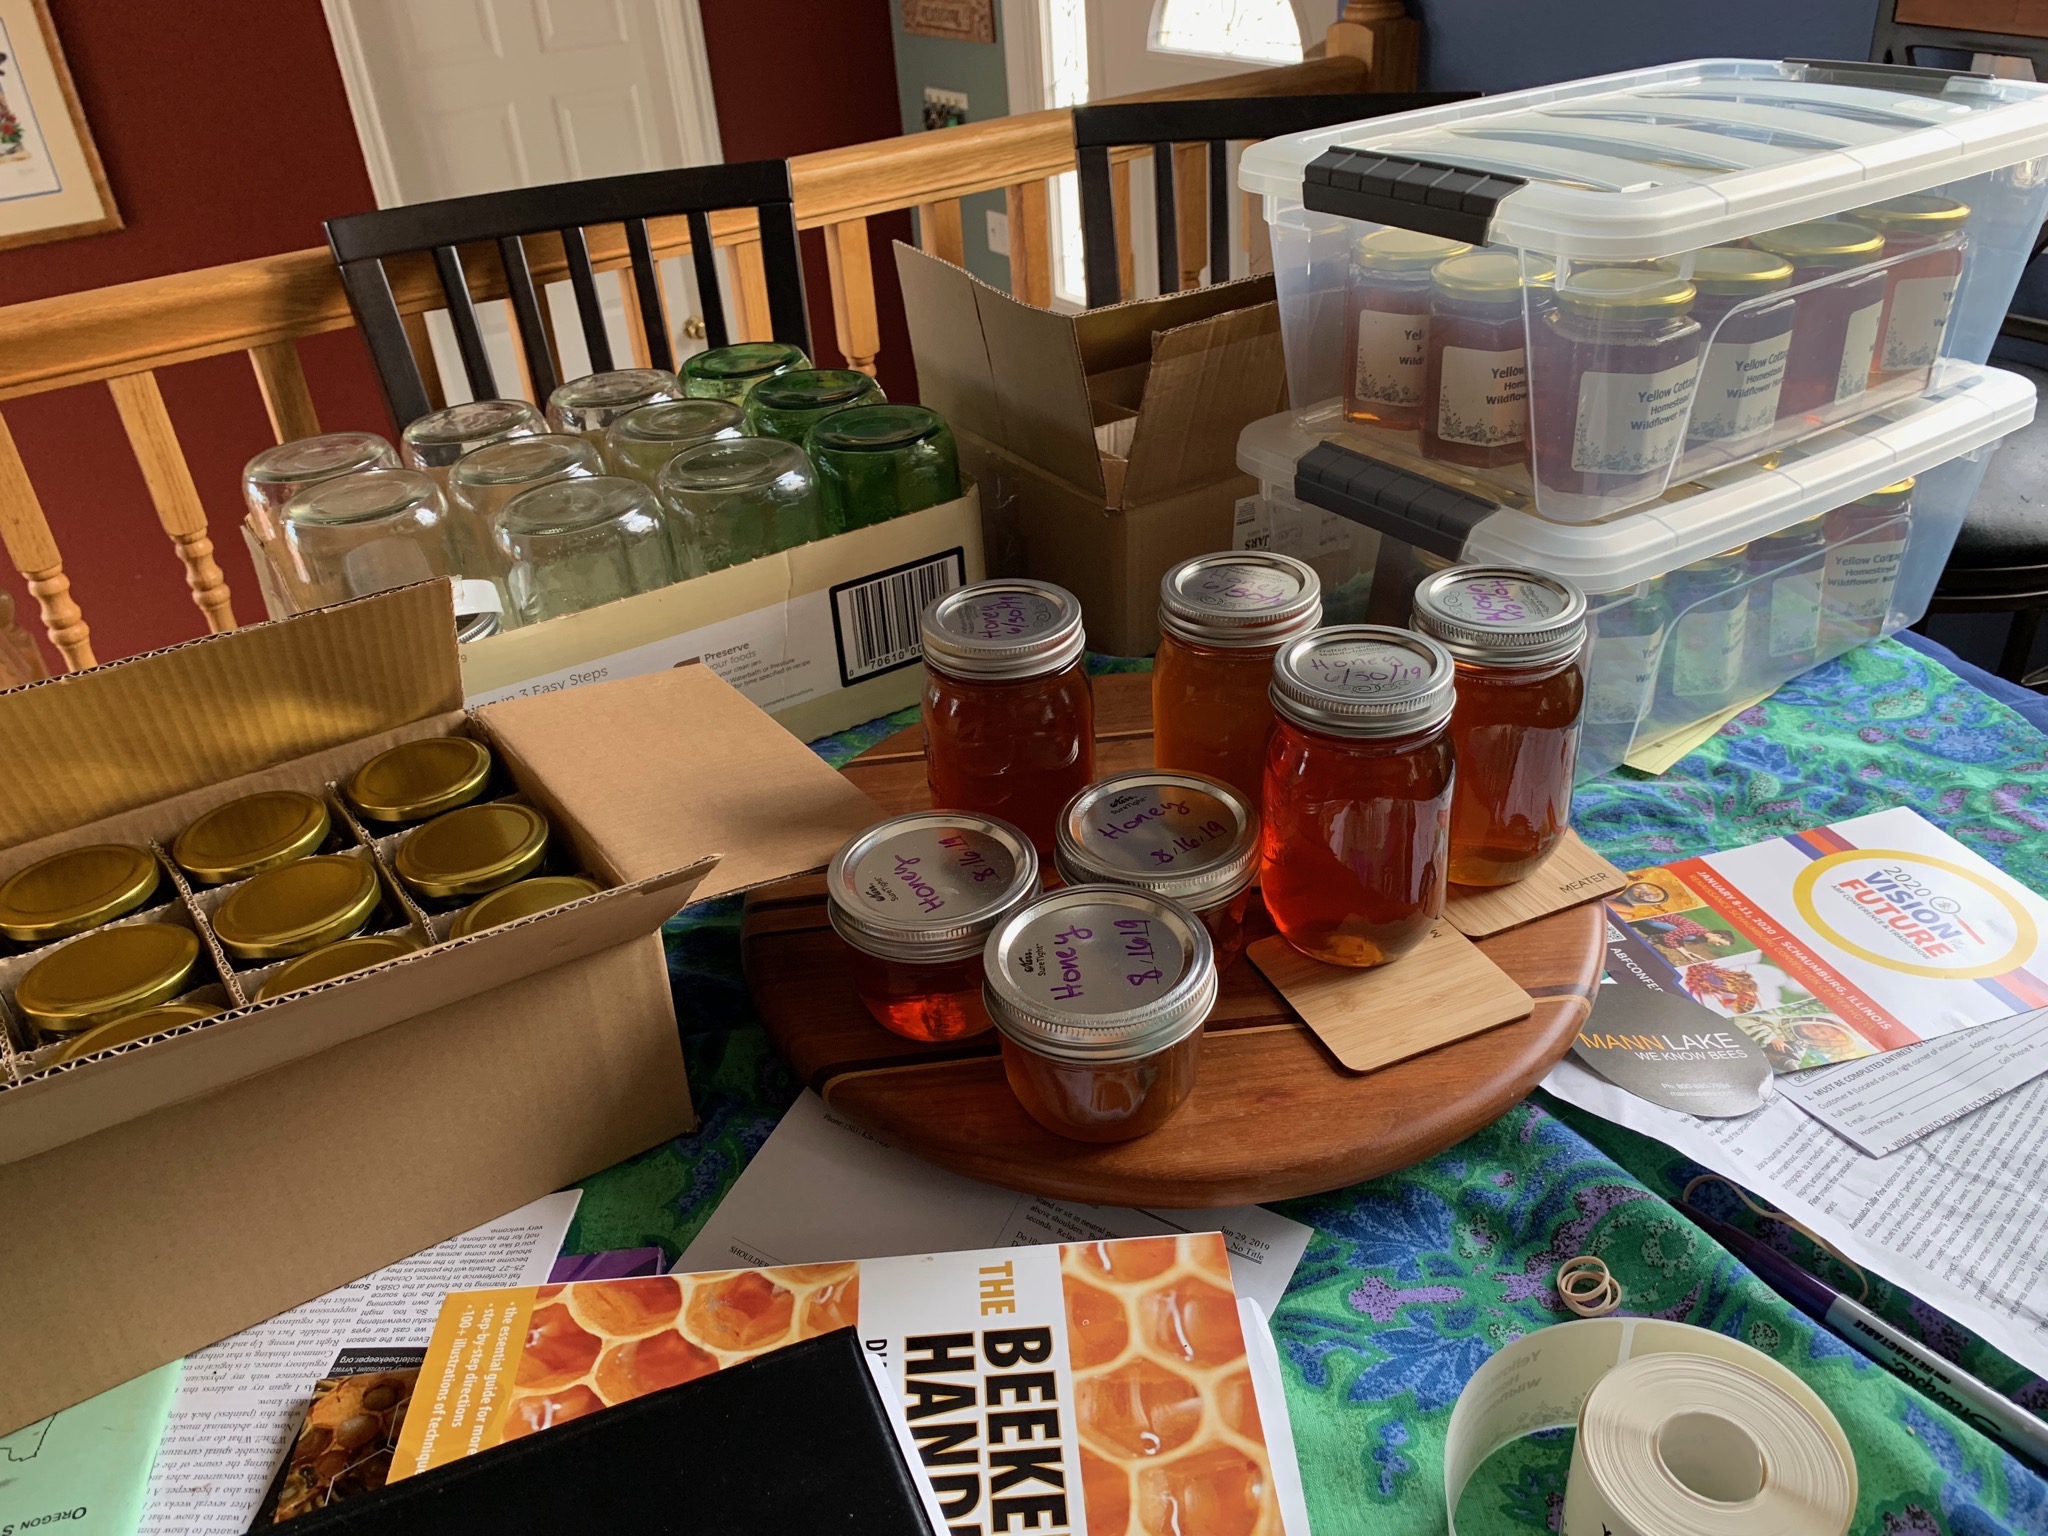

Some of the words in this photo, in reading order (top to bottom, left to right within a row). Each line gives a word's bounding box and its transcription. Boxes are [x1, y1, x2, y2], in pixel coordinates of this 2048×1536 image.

[1734, 354, 1768, 373] Yellow
[1638, 385, 1672, 403] Yellow
[1726, 380, 1771, 400] Wildflower
[1630, 411, 1680, 432] Wildflower
[1244, 534, 1270, 550] JARS
[1492, 577, 1526, 623] Honey
[978, 603, 1001, 639] Honey
[703, 641, 750, 661] Preserve
[729, 649, 757, 665] foods
[847, 668, 855, 676] 0
[869, 650, 906, 669] 70610
[909, 643, 923, 656] 00
[1310, 654, 1403, 671] Honey
[531, 677, 567, 696] Easy
[569, 665, 610, 688] Steps
[1097, 798, 1191, 842] Honey
[1150, 819, 1228, 867] 8/16/19
[894, 854, 946, 914] Honey
[1558, 870, 1609, 895] MEATER
[1881, 865, 1932, 897] 2020
[1863, 870, 1963, 939] VISION
[1830, 885, 1845, 894] ABF
[1841, 894, 1885, 924] CONFERENCE
[1887, 928, 1931, 959] TRADESHOW
[1837, 877, 1953, 957] FUTURE
[1034, 943, 1046, 976] SureTight
[1049, 924, 1094, 1001] Honey
[1113, 919, 1163, 986] 8/16/19
[1695, 870, 1737, 901] JANUARY
[1730, 899, 1755, 919] 8-11,
[1752, 918, 1776, 934] 2020
[1781, 942, 1847, 995] SCHAUMBURG,
[1845, 995, 1895, 1031] ILLINOIS
[1579, 1033, 1665, 1049] MANN
[1661, 1032, 1739, 1049] LAKE
[1969, 1034, 1996, 1049] Address:
[1993, 1040, 2011, 1052] City:
[1633, 1052, 1661, 1060] WE
[1661, 1050, 1706, 1060] KNOW
[1706, 1049, 1747, 1060] BEES
[1997, 1055, 2011, 1065] Cell
[2008, 1046, 2030, 1059] Phone
[1812, 1083, 1836, 1098] MUST
[1834, 1079, 1846, 1087] BE
[1843, 1061, 1884, 1083] COMPLETED
[1881, 1046, 1913, 1065] ENTIRELY
[1817, 1092, 1848, 1110] Customer
[1851, 1078, 1880, 1095] (Located
[1885, 1070, 1898, 1079] top
[1895, 1061, 1912, 1073] right
[1910, 1052, 1931, 1065] corner
[1936, 1038, 1957, 1050] invoice
[1830, 1109, 1845, 1118] Full
[1841, 1098, 1866, 1113] Name:
[1843, 1112, 1869, 1127] E-mail:
[1890, 1132, 1917, 1148] WHAT
[1914, 1120, 1942, 1136] WOULD
[1940, 1112, 1958, 1123] YOU
[1955, 1105, 1971, 1115] LIKE
[1968, 1099, 1982, 1108] US
[1988, 1087, 2005, 1097] DO?
[1857, 1123, 1880, 1136] Home
[1876, 1113, 1899, 1127] Phone
[1874, 1185, 1887, 1199] Fine
[488, 1225, 524, 1233] welcome.
[1024, 1213, 1054, 1232] seconds.
[1029, 1203, 1051, 1219] above
[1049, 1214, 1085, 1236] shoulders.
[1080, 1217, 1106, 1234] neutral
[1015, 1230, 1028, 1241] Do
[1220, 1224, 1235, 1237] Jun
[1234, 1231, 1248, 1243] 29,
[1248, 1237, 1271, 1252] 2019
[1230, 1241, 1245, 1252] No
[1244, 1246, 1266, 1261] Title
[474, 1280, 506, 1288] learning
[978, 1260, 1017, 1316] THE
[454, 1307, 475, 1337] 100+
[500, 1305, 517, 1326] the
[463, 1307, 494, 1372] step-by-step
[487, 1324, 511, 1372] essential
[1853, 1318, 1934, 1376] RETRACTABLE
[435, 1336, 467, 1403] illustrations
[477, 1371, 499, 1404] guide
[432, 1401, 447, 1417] of
[450, 1372, 476, 1428] directions
[474, 1403, 491, 1424] for
[466, 1424, 483, 1456] more
[903, 1330, 984, 1536] HAND
[981, 1324, 1072, 1536] BEEKE
[164, 1484, 212, 1495] beekeeper.
[164, 1501, 190, 1509] weeks
[193, 1500, 226, 1508] several
[230, 1500, 254, 1510] After
[147, 1514, 170, 1522] what
[172, 1514, 200, 1522] know
